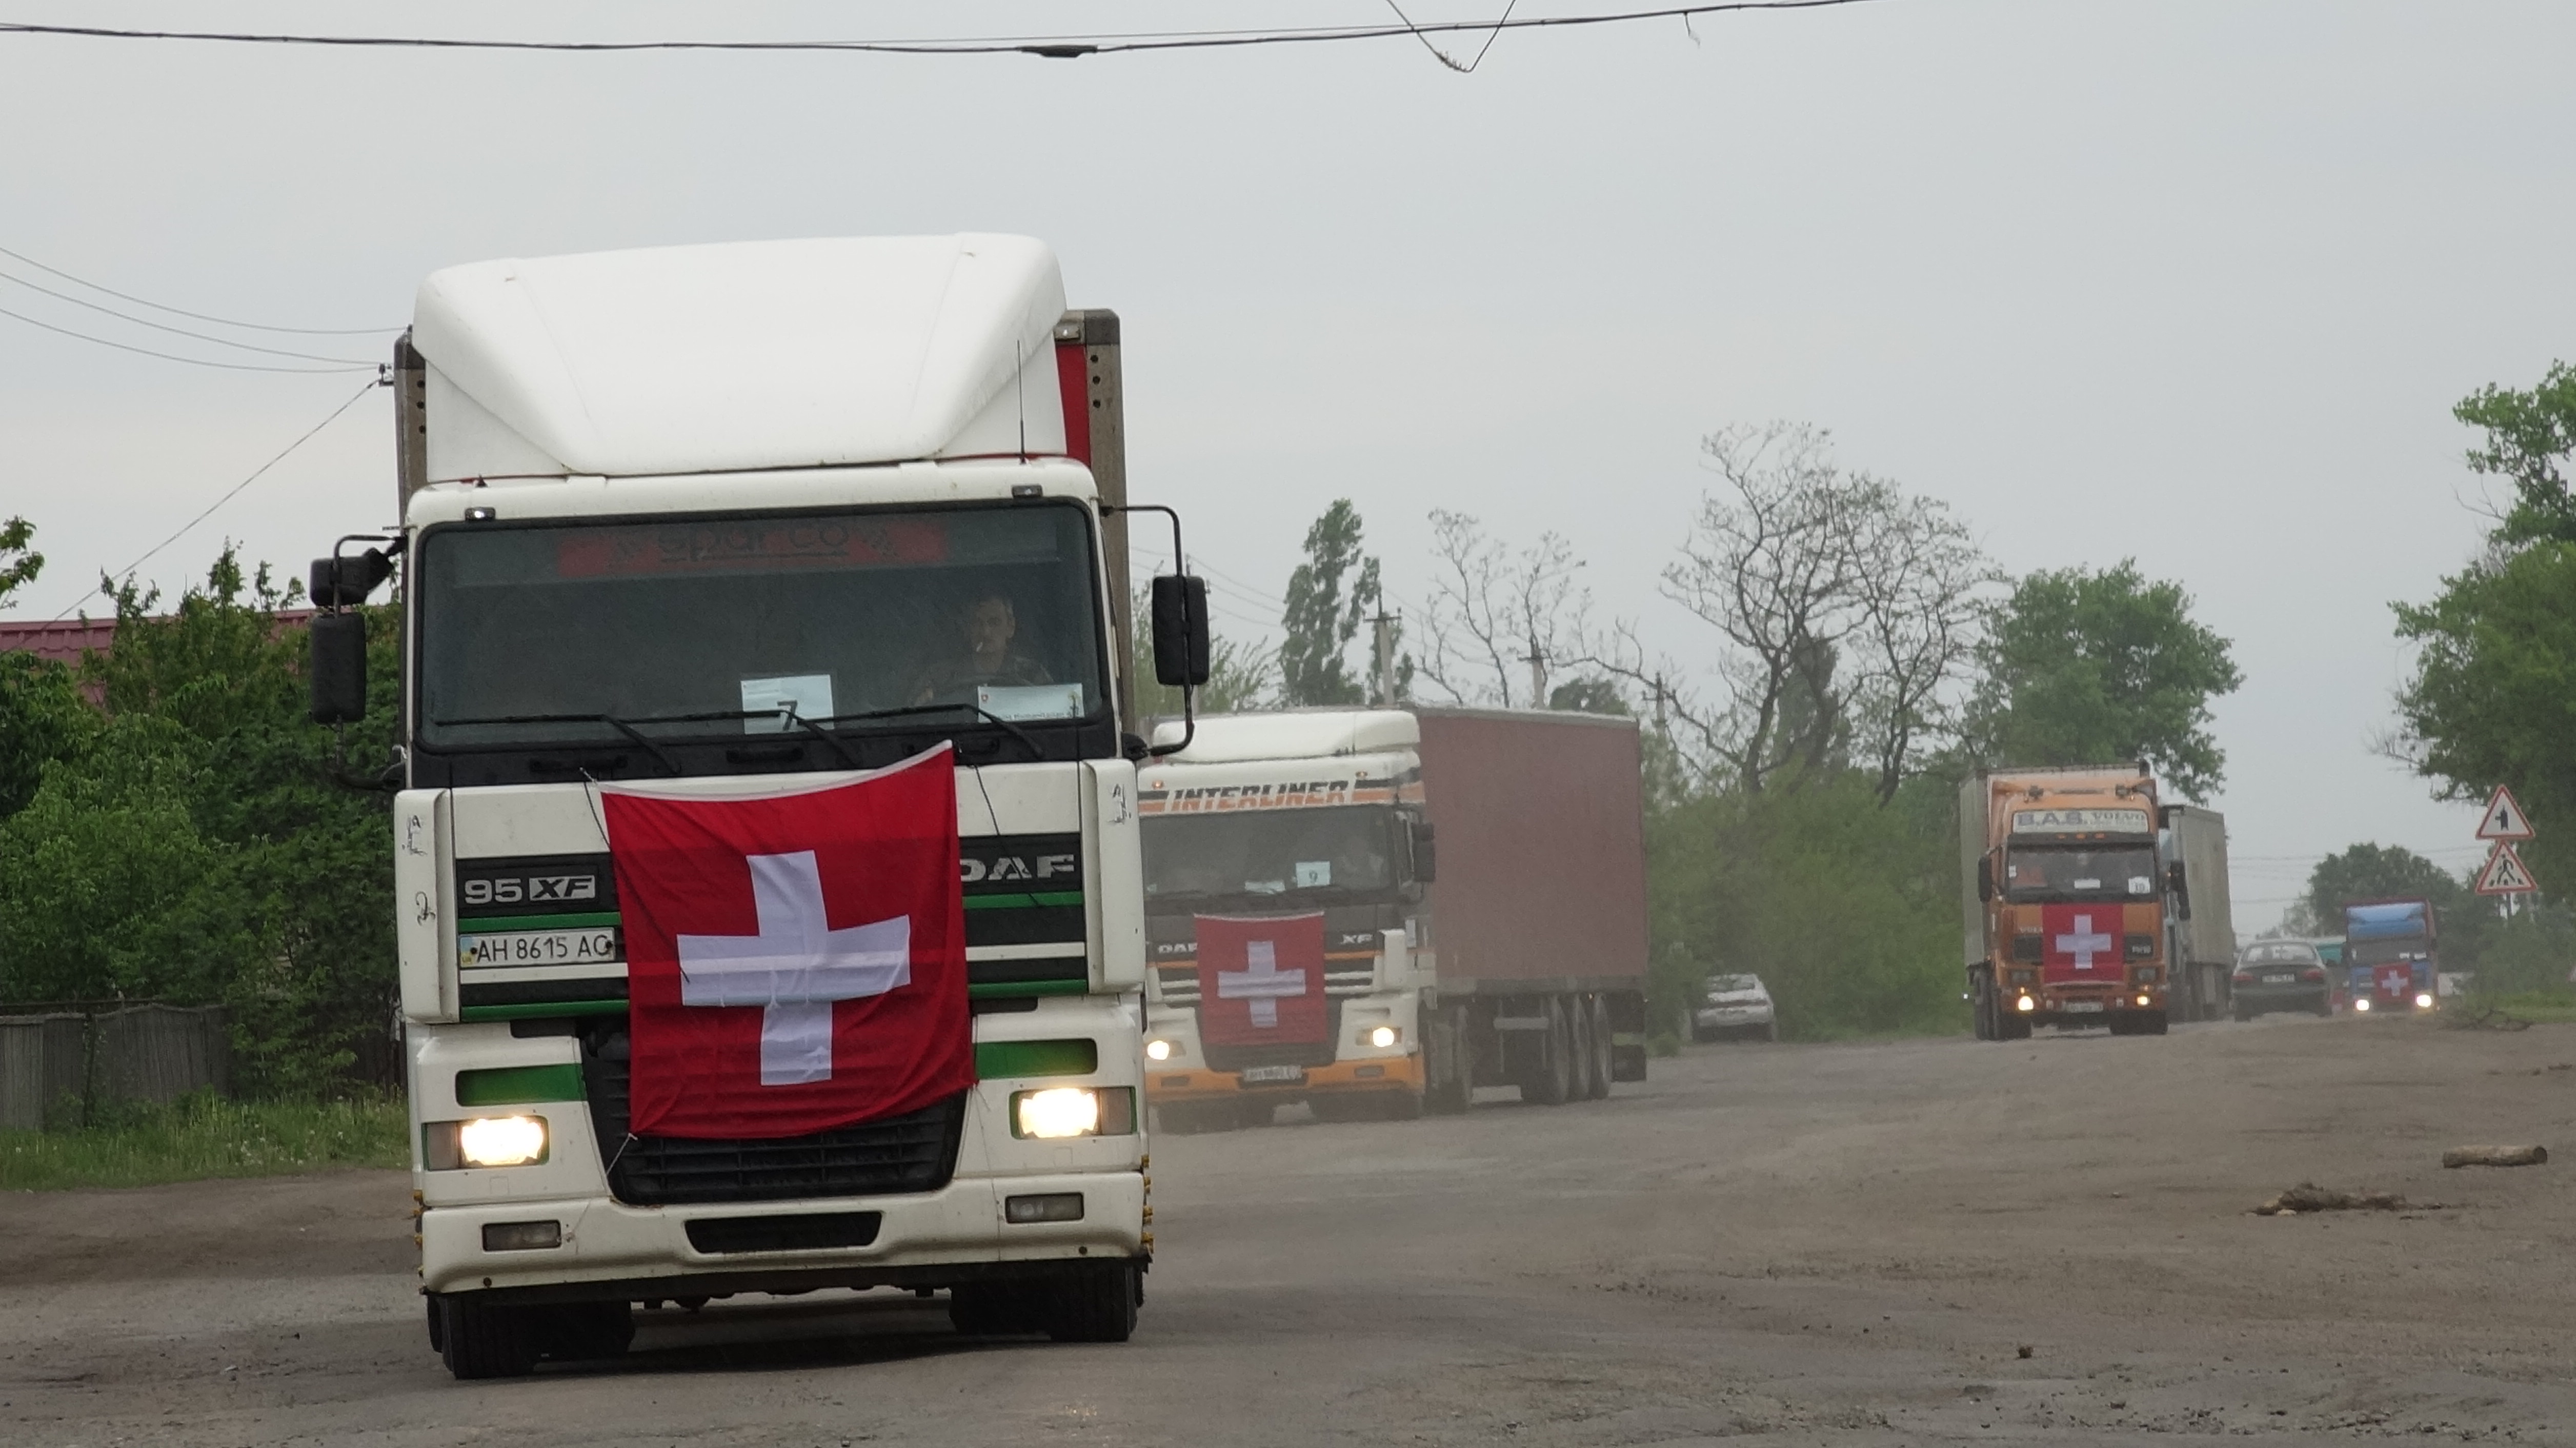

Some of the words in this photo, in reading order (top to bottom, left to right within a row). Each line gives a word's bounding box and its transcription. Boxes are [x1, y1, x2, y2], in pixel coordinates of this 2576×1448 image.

[777, 700, 798, 731] 7
[1171, 780, 1349, 812] INTERLINER
[959, 854, 1074, 882] DAF
[465, 878, 522, 904] 95
[531, 877, 593, 899] XF
[477, 939, 508, 963] AH
[516, 936, 568, 959] 8615
[1340, 933, 1374, 944] XF
